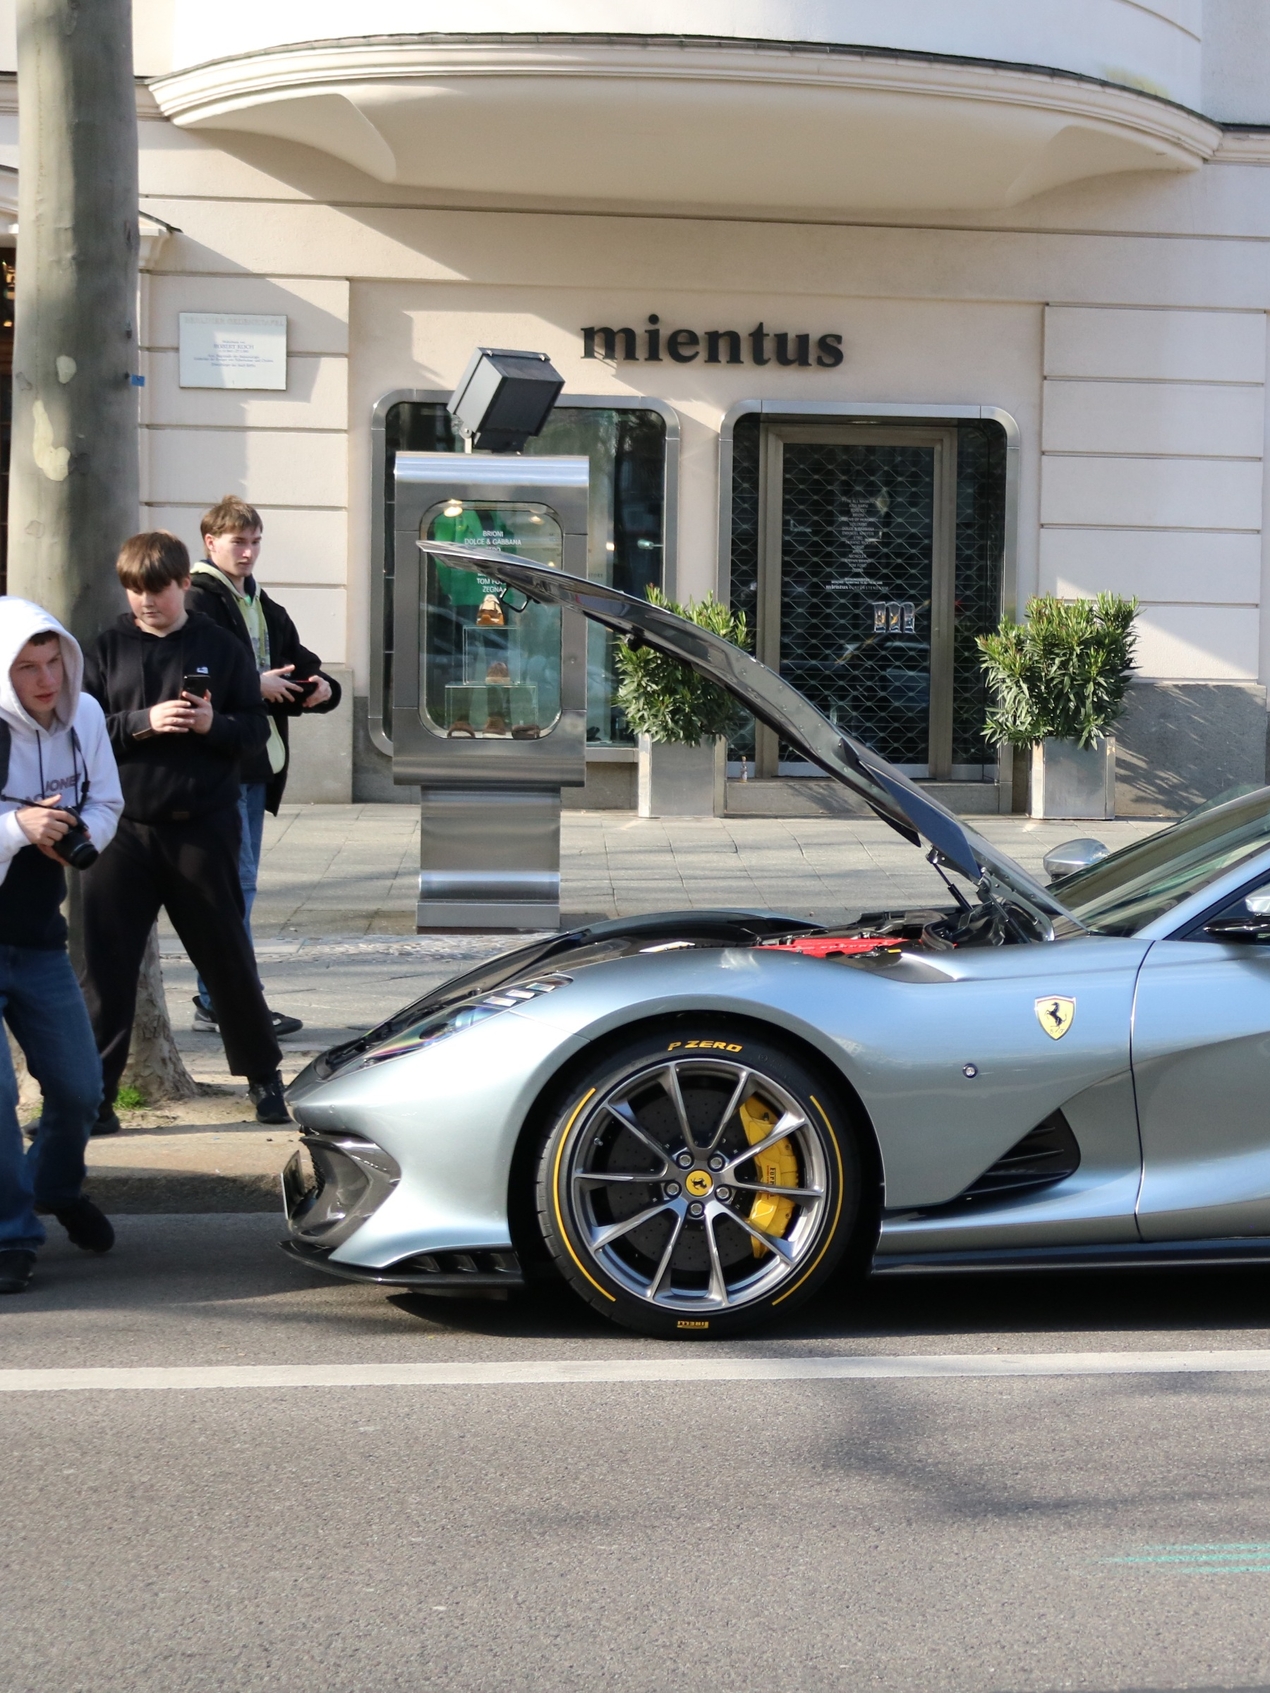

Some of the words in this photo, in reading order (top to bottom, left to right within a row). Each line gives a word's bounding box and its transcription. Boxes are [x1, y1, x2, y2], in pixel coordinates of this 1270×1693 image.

[580, 313, 844, 368] mientus
[667, 1041, 681, 1051] P
[684, 1040, 743, 1053] ZERO
